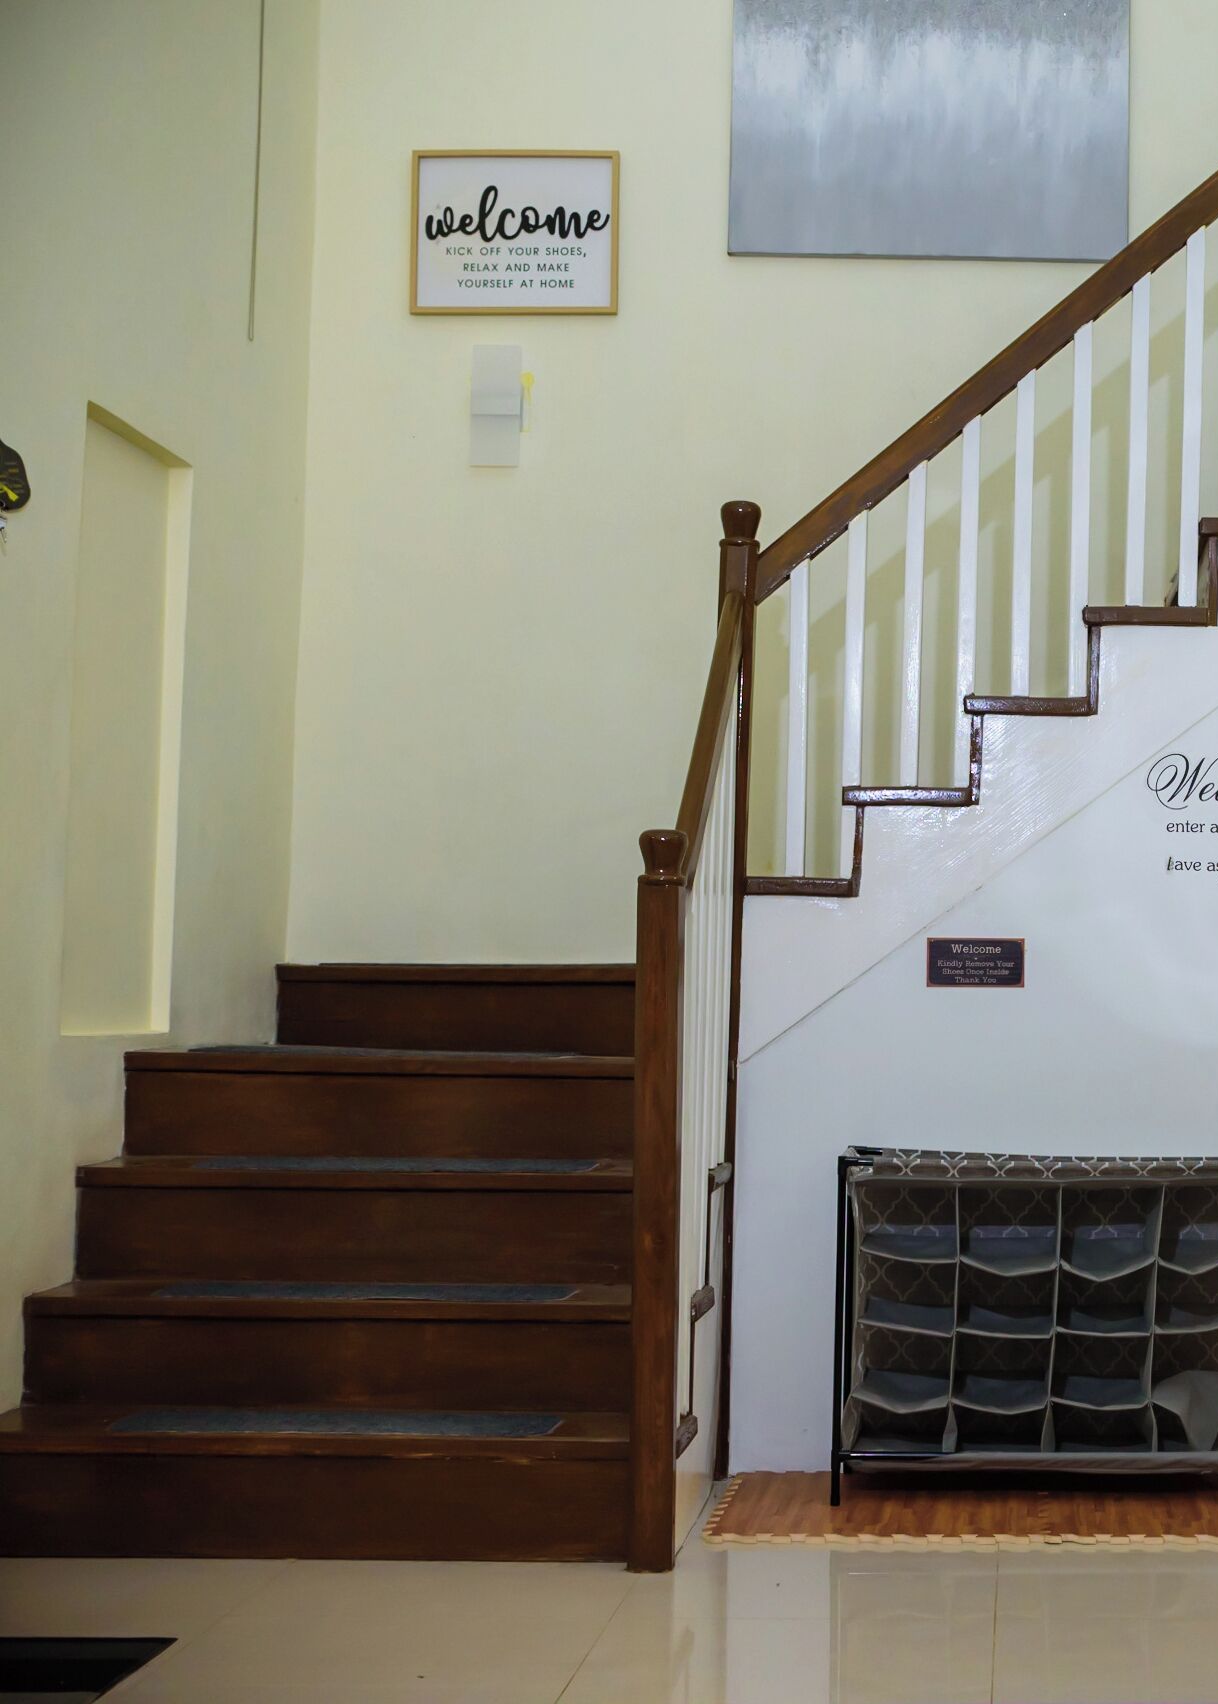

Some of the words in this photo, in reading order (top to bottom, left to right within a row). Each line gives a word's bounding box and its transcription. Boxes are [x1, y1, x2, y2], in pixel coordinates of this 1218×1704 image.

[425, 185, 610, 242] welcome
[446, 246, 473, 256] KICK
[480, 246, 501, 256] OFF
[508, 246, 540, 256] YOUR
[545, 246, 587, 257] SHOES,
[463, 263, 498, 272] RELAX
[505, 263, 530, 272] AND
[537, 263, 569, 272] MAKE
[457, 279, 514, 288] YOURSELF
[520, 279, 534, 288] AT
[540, 279, 574, 288] HOME
[1166, 820, 1205, 833] enter
[951, 944, 1001, 953] Welcome
[996, 960, 1015, 968] Your
